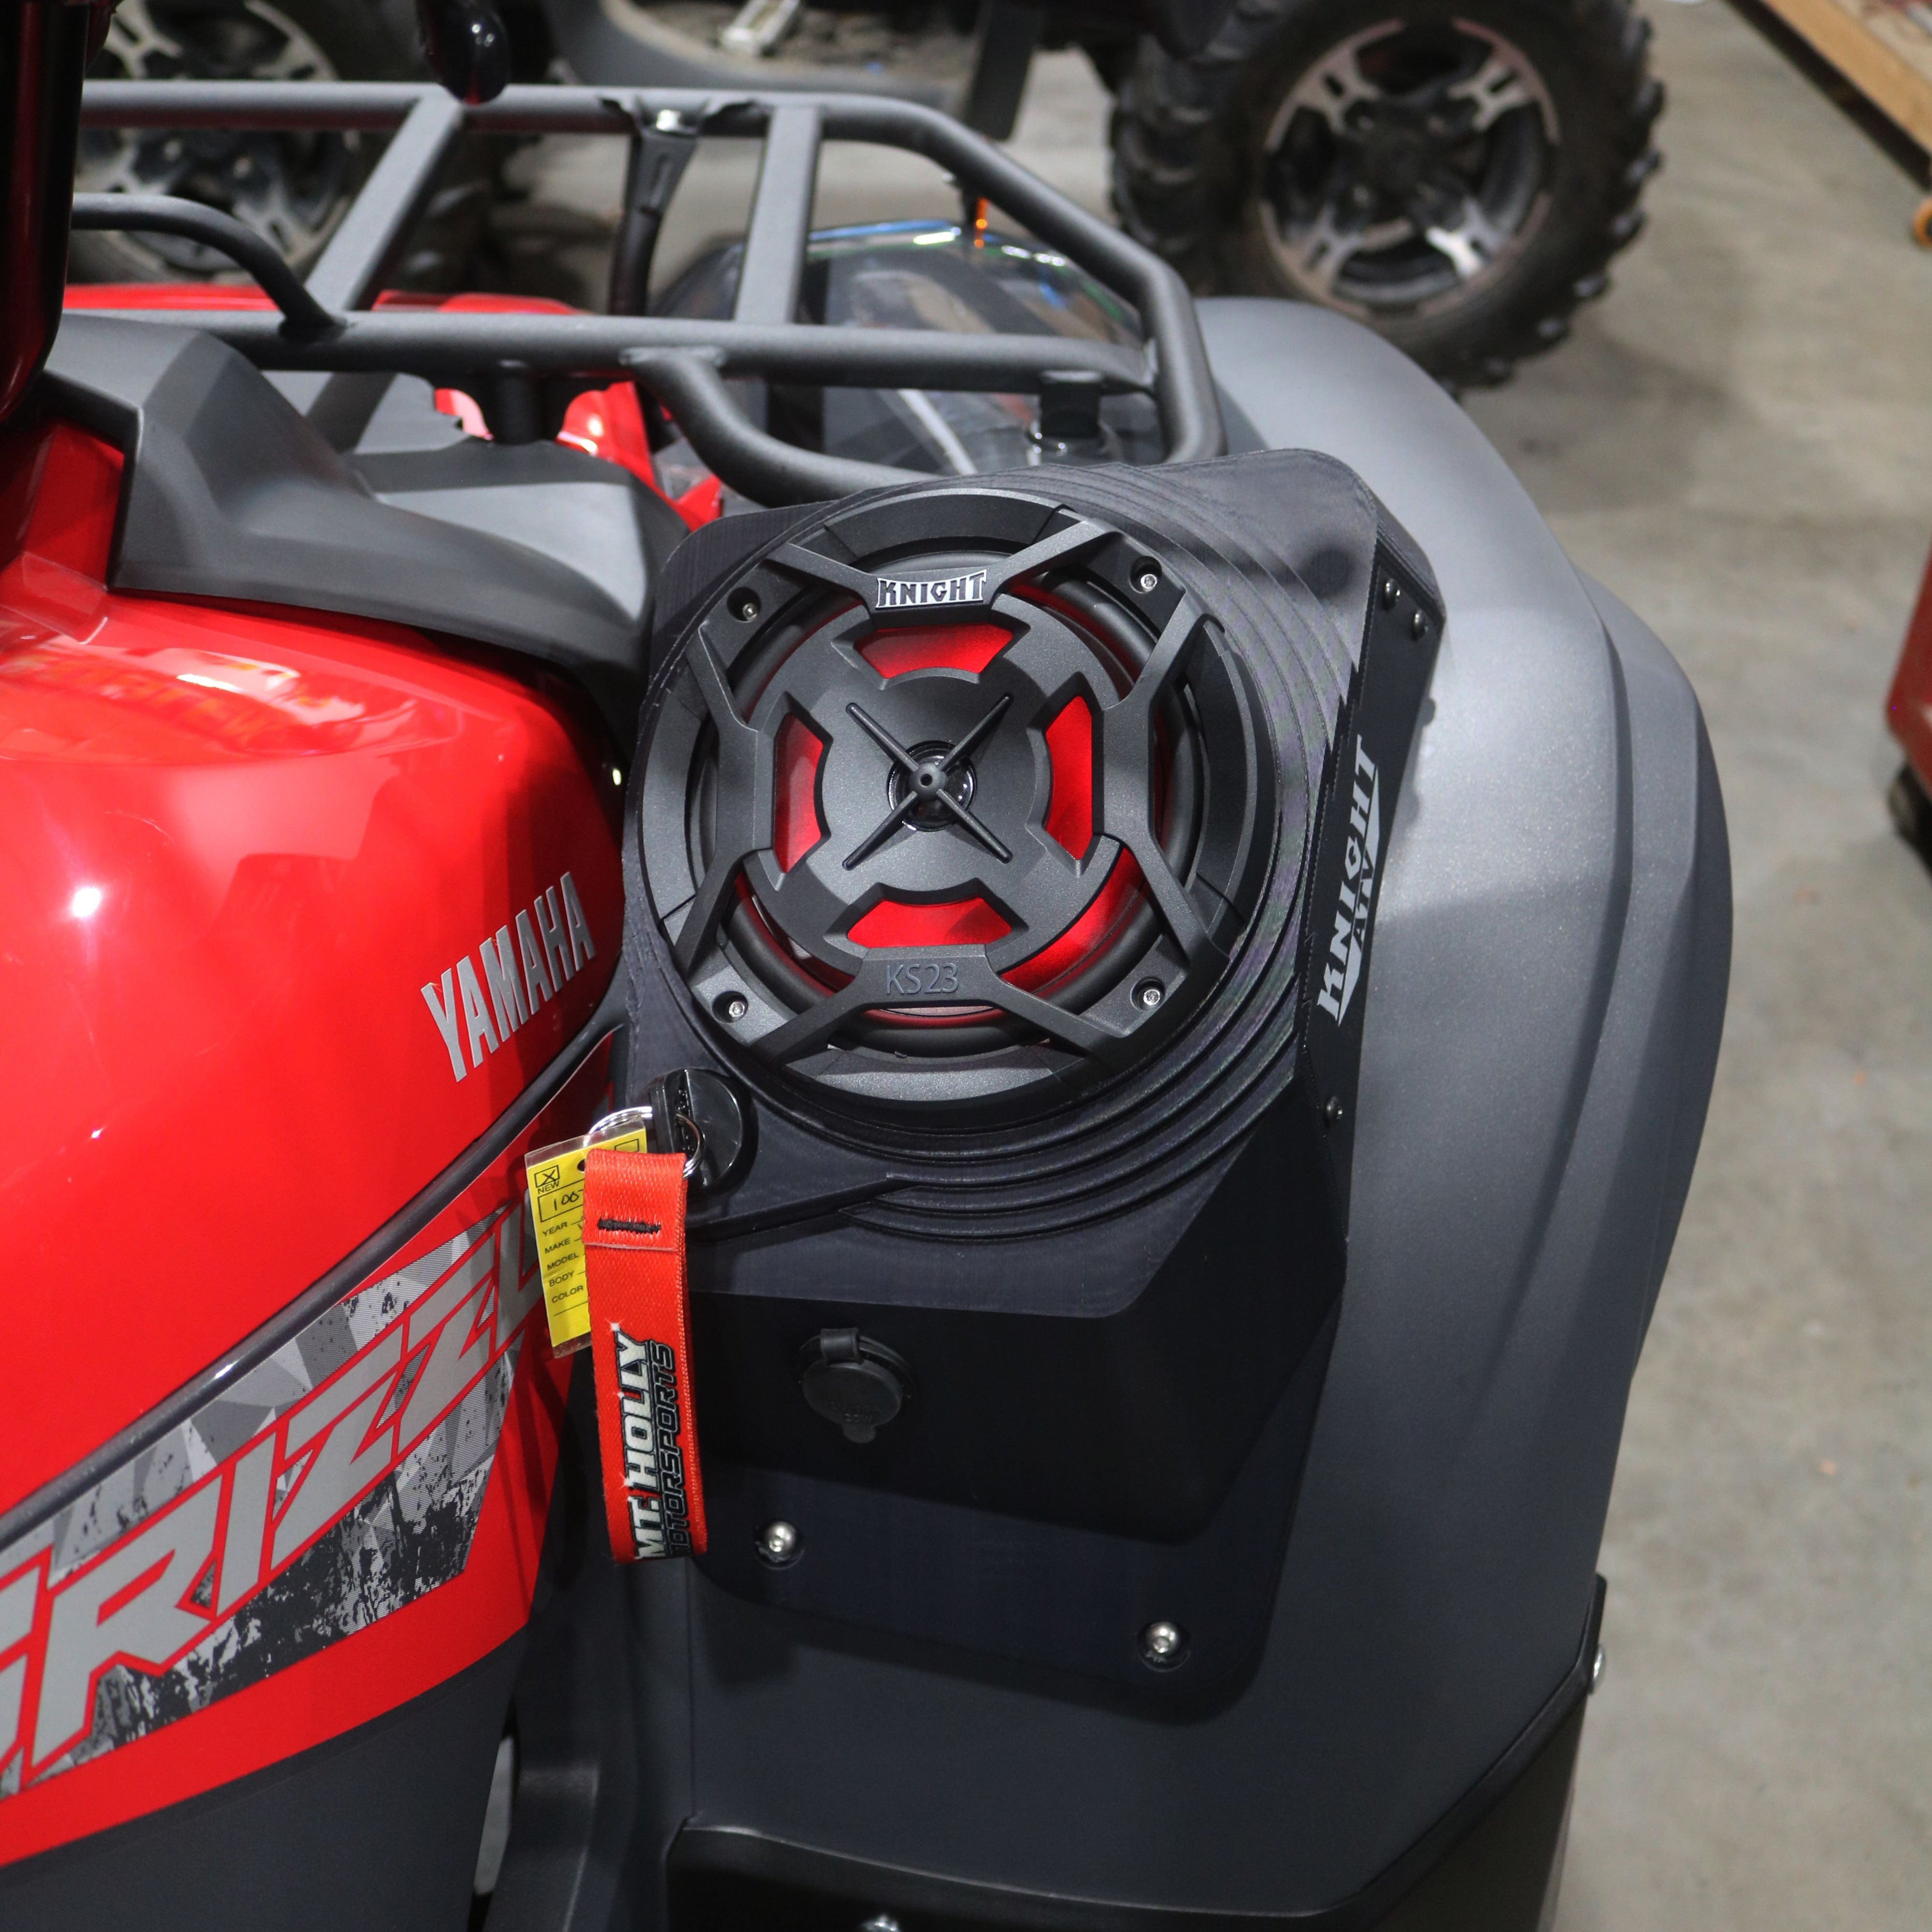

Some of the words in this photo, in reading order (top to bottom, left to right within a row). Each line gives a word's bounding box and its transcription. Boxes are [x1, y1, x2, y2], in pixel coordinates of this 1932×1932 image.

[877, 570, 986, 608] KNIGHT
[1317, 734, 1376, 1022] KNIGHT
[421, 872, 596, 1082] YAMAHA
[886, 963, 958, 995] KS23
[538, 1180, 559, 1194] NEW
[554, 1189, 583, 1211] 100
[542, 1222, 568, 1236] YEAR
[545, 1238, 570, 1254] MAKE
[547, 1253, 579, 1271] MODEL
[549, 1271, 574, 1287] BODY
[552, 1285, 583, 1303] COLOR
[615, 1330, 660, 1492] HOLLY
[0, 1202, 548, 1776] RIZZL
